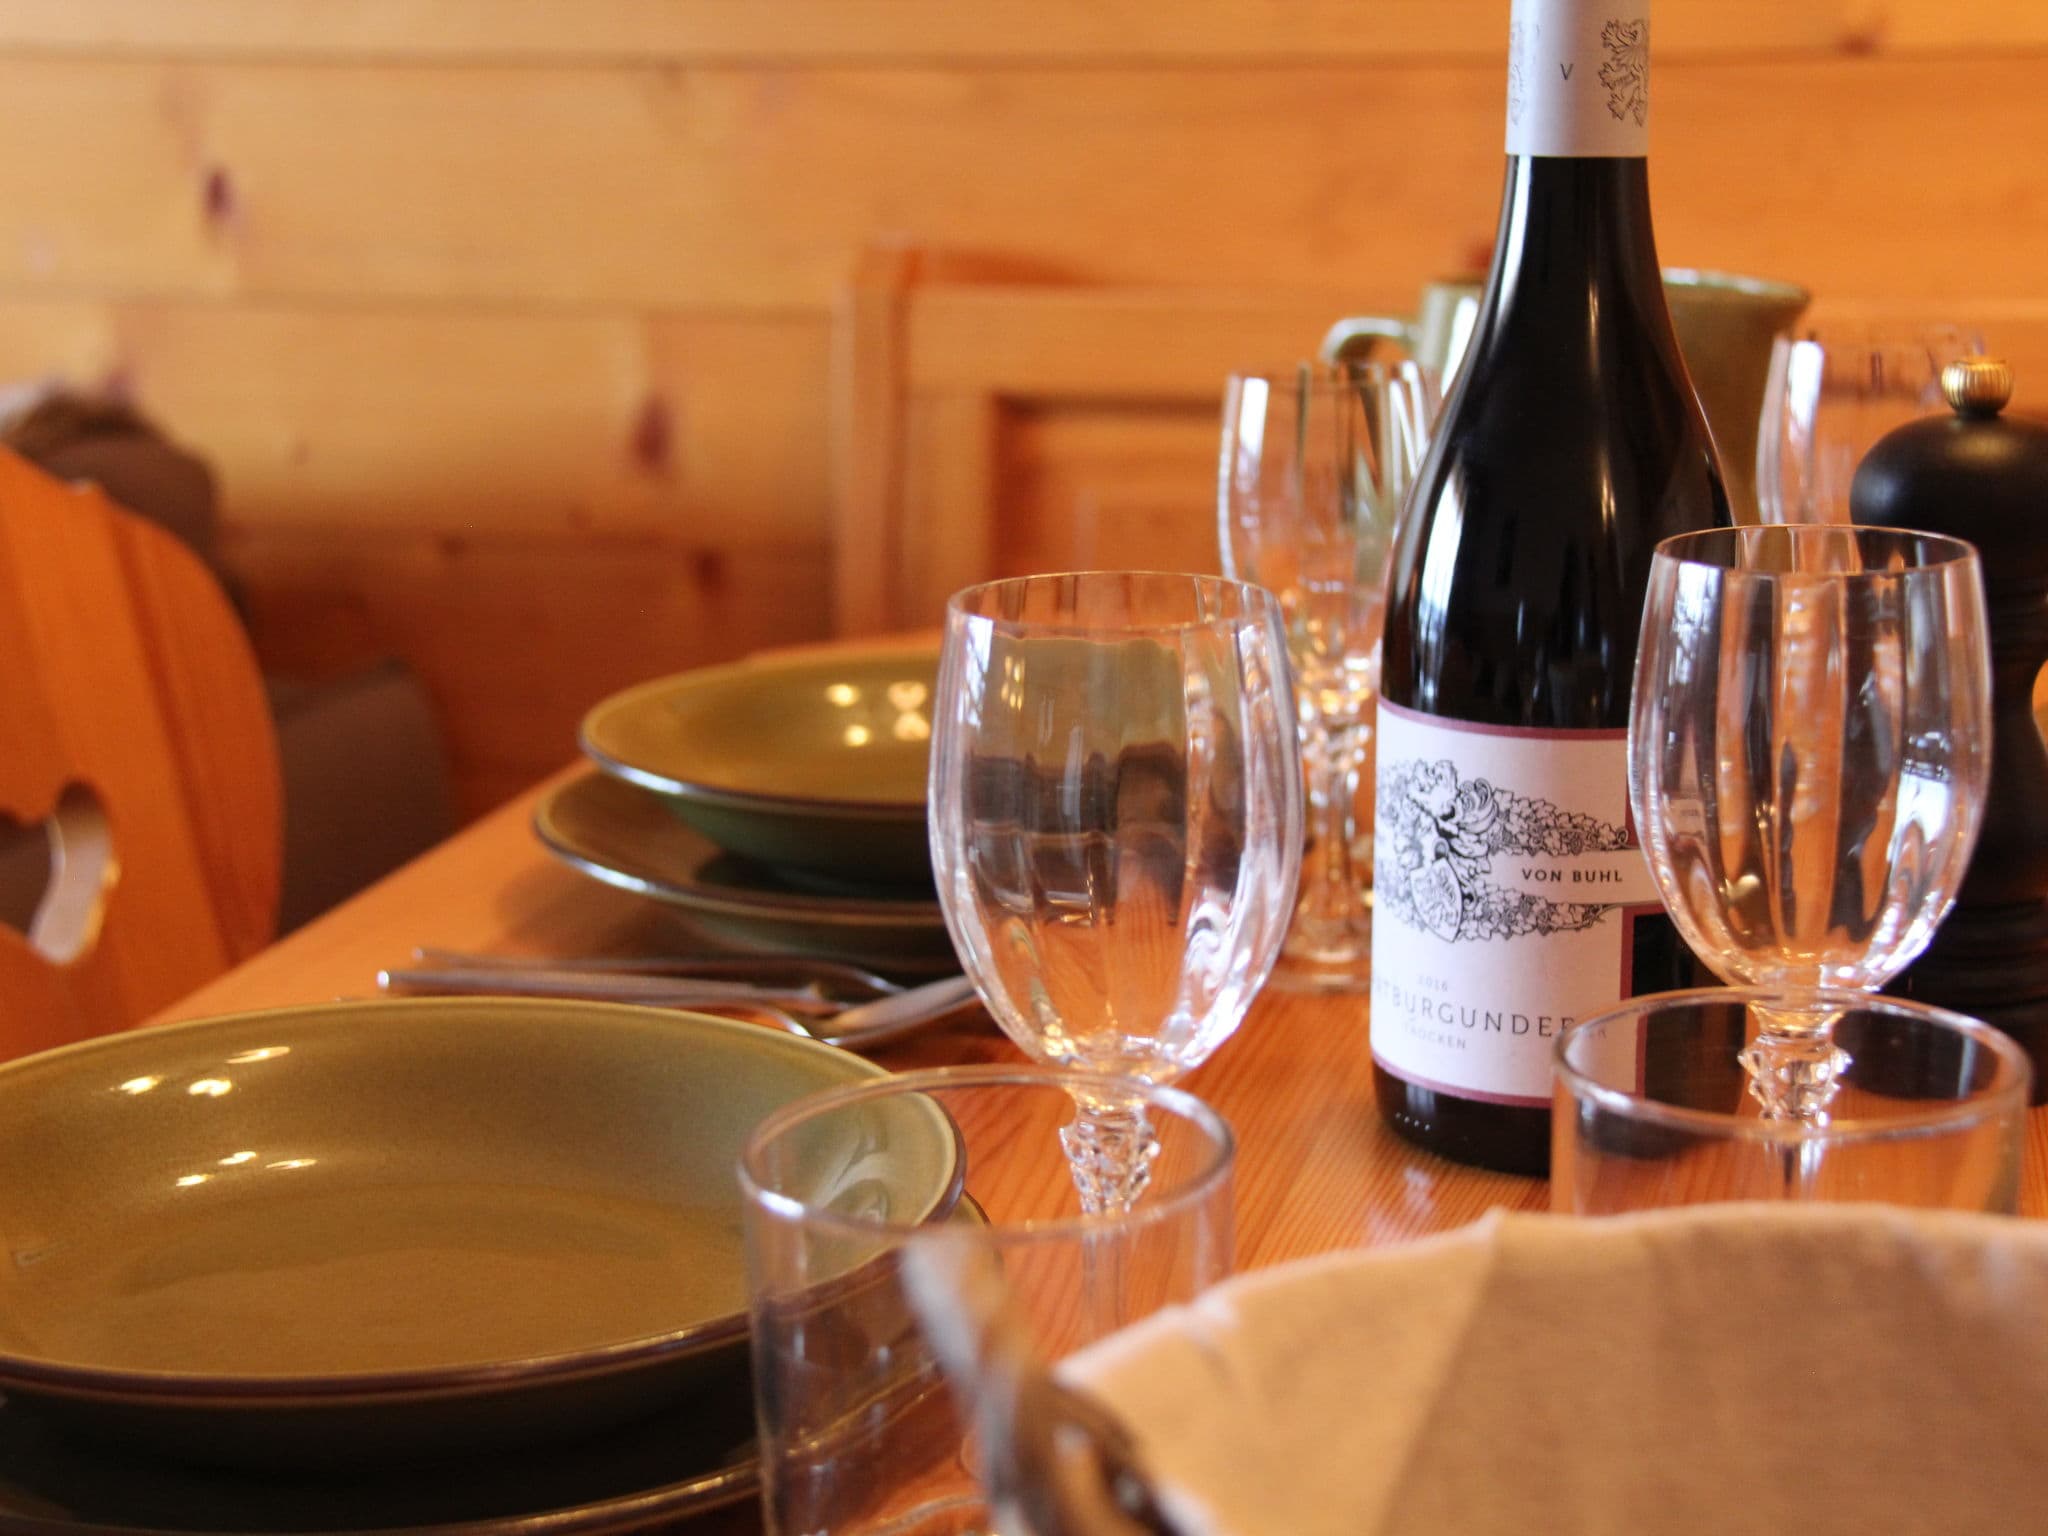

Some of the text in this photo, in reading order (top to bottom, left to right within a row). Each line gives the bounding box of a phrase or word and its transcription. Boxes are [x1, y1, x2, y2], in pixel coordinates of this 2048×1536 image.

[1560, 63, 1574, 81] V
[1522, 868, 1623, 883] VON BUHL
